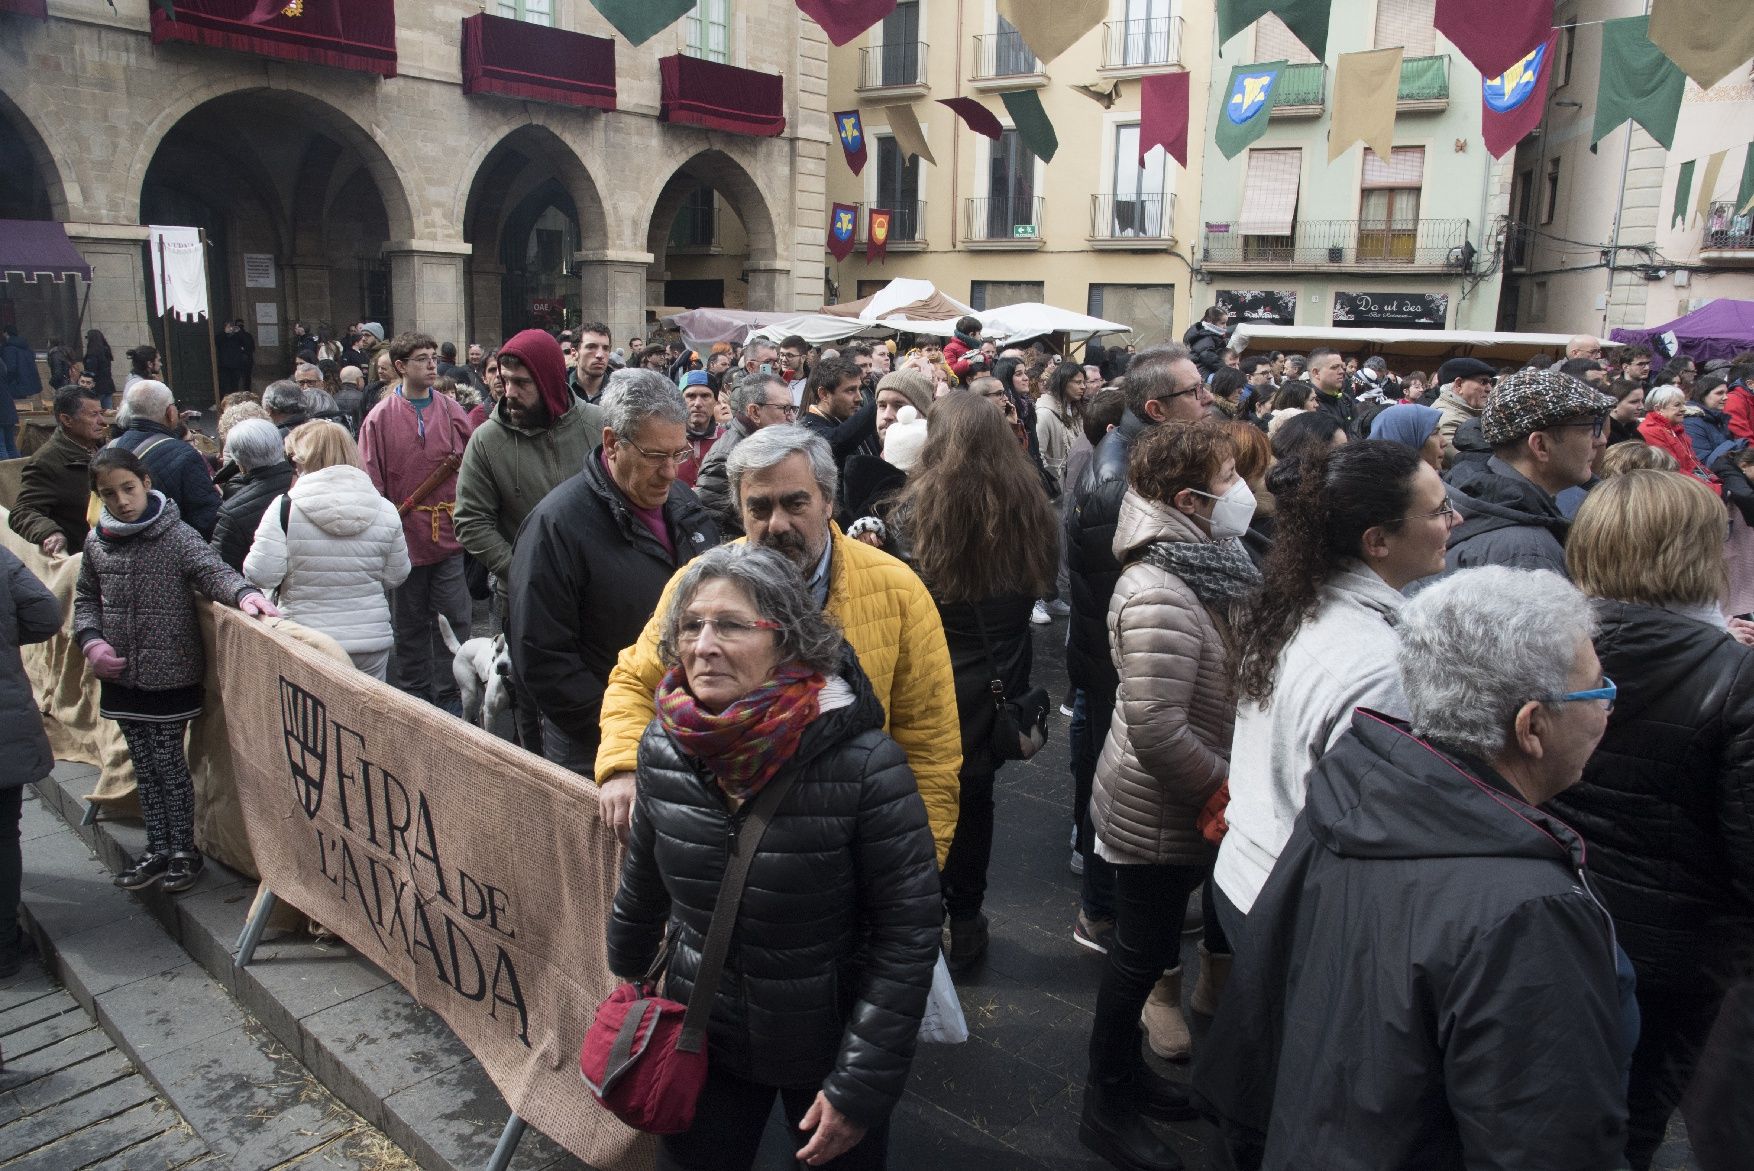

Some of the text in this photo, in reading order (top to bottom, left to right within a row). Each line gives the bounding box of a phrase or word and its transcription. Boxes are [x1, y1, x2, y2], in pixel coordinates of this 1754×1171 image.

[1357, 295, 1423, 312] Do ut des
[317, 828, 532, 1048] L'AIXADA
[331, 720, 459, 906] FIRA
[458, 869, 515, 939] DE
